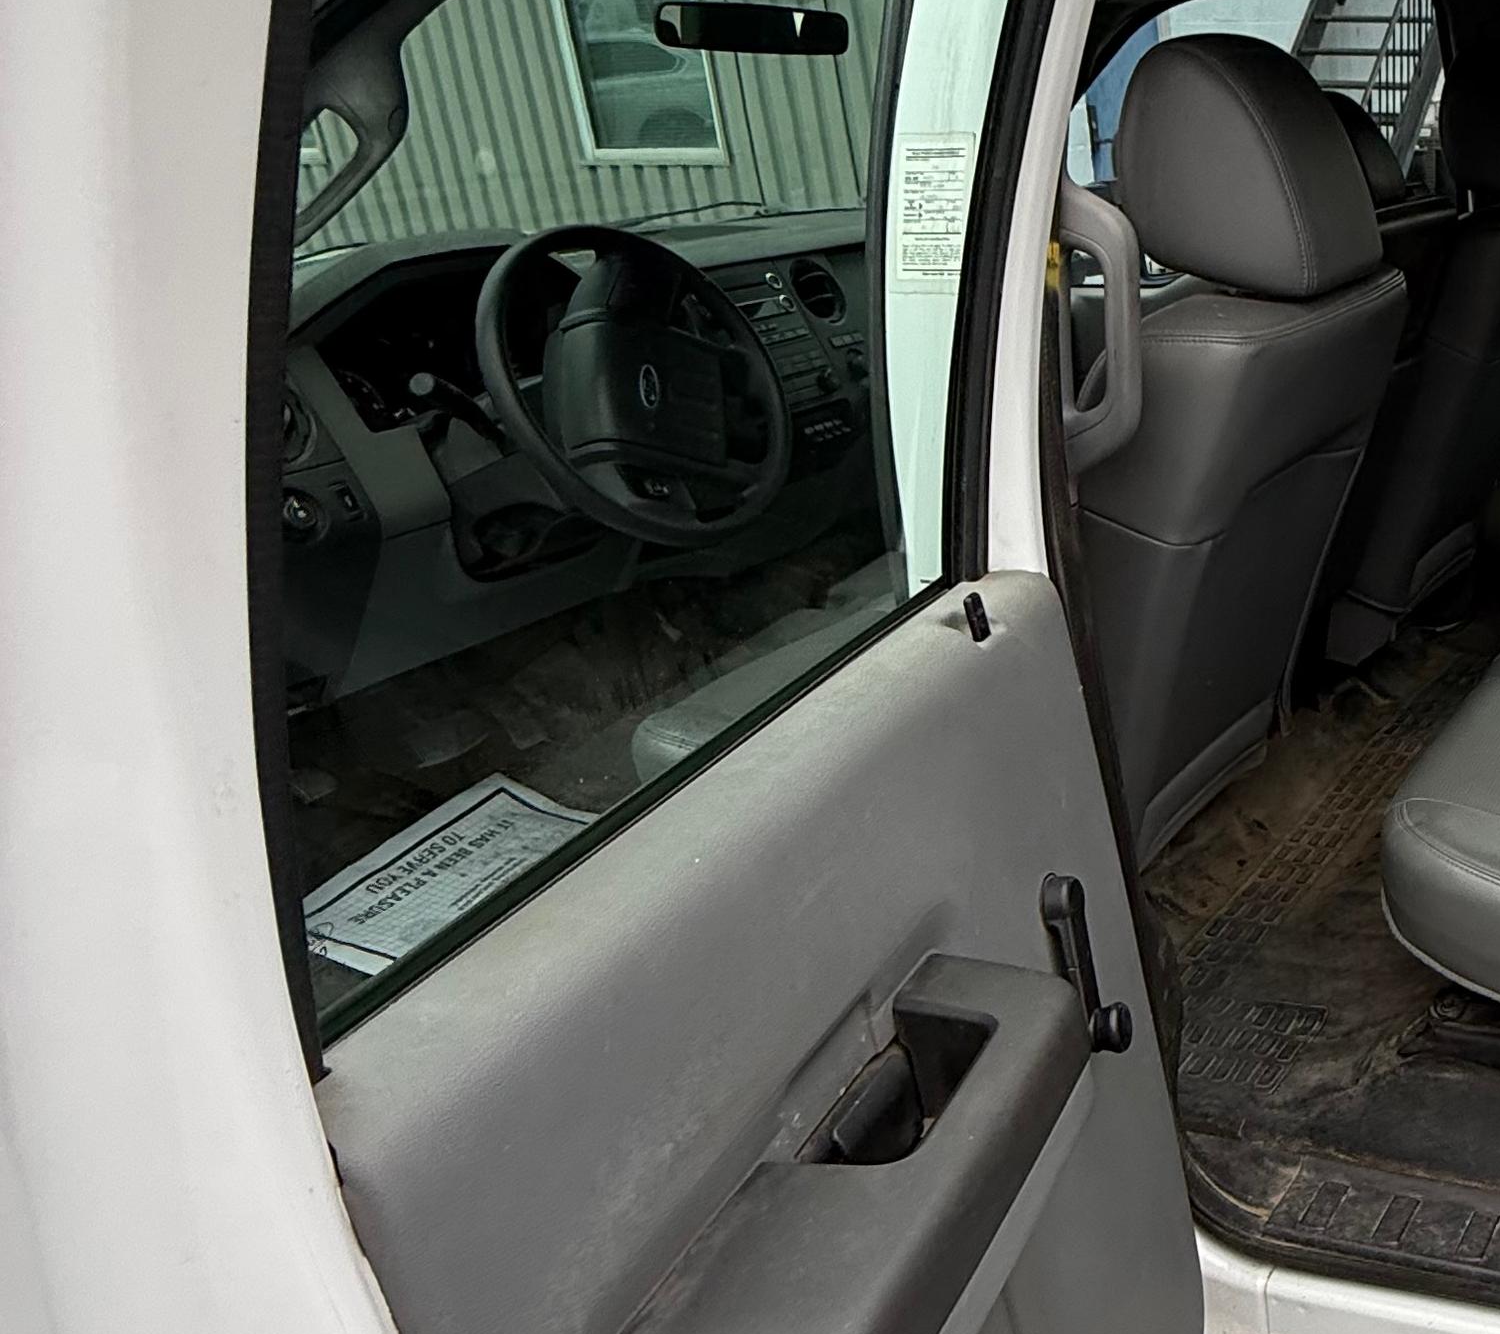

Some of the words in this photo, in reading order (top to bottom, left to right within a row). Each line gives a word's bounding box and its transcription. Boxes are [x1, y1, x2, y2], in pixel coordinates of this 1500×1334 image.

[497, 819, 515, 831] IT
[441, 831, 466, 846] TO
[468, 828, 501, 849] HAS
[396, 842, 447, 876] SERVE
[433, 847, 474, 870] BEEN
[365, 873, 402, 894] YOU
[421, 868, 439, 878] A
[347, 877, 427, 925] PLEASURE
